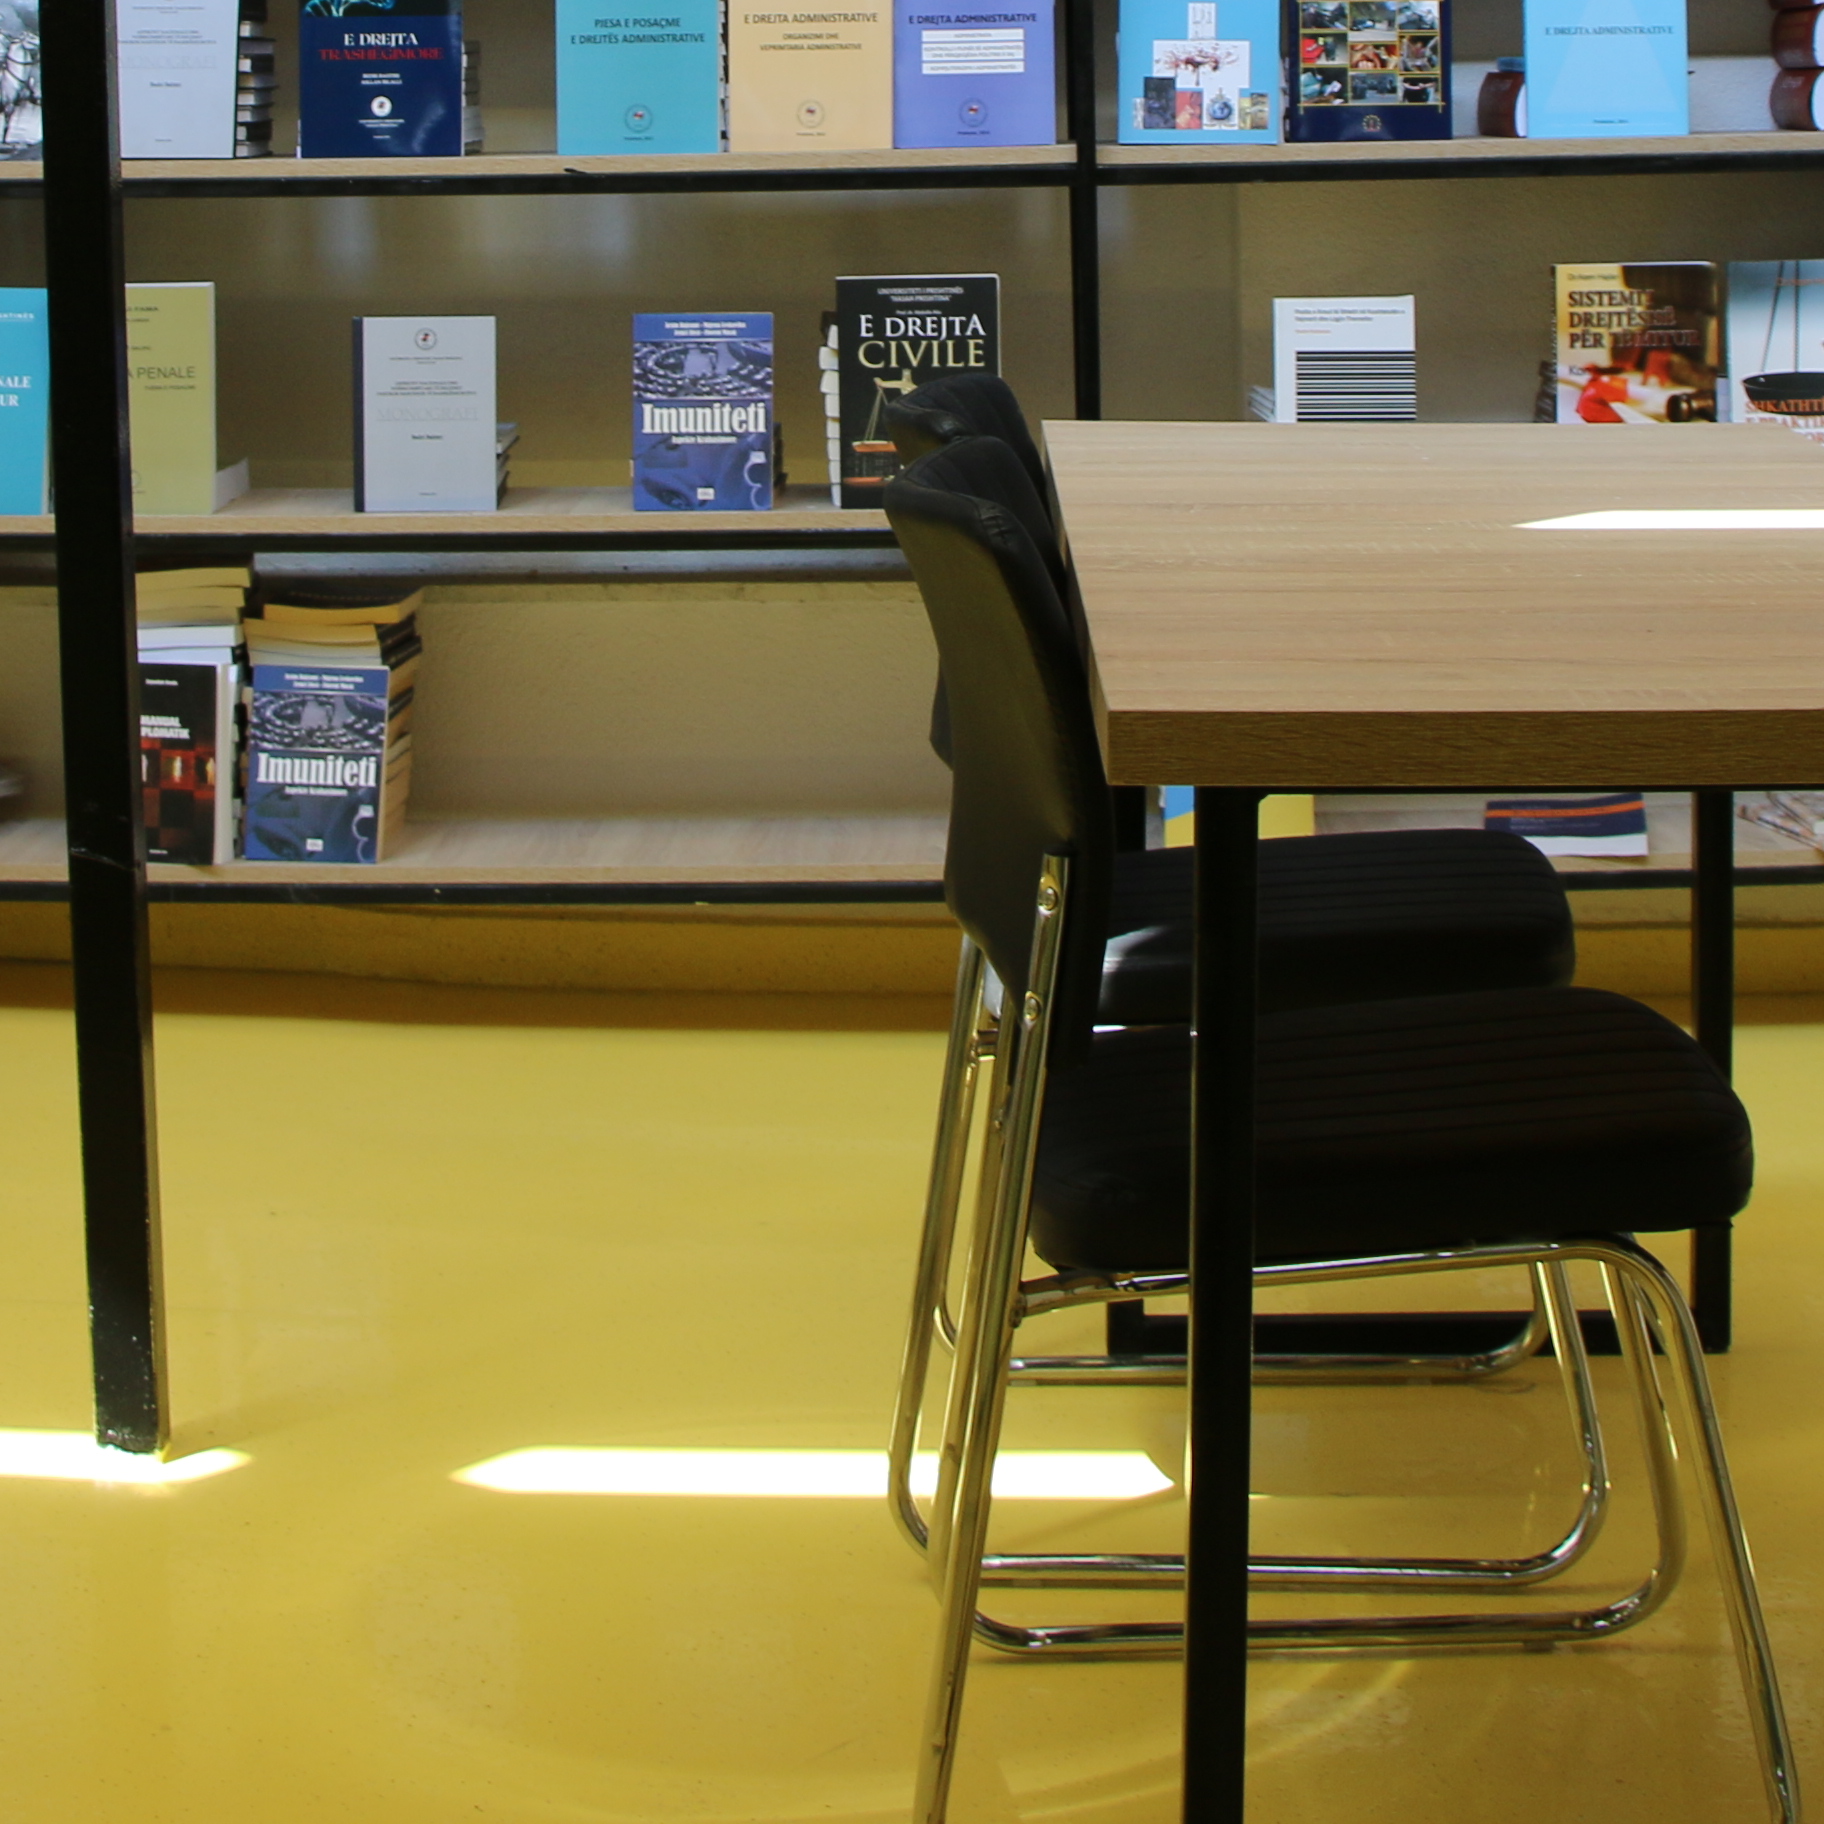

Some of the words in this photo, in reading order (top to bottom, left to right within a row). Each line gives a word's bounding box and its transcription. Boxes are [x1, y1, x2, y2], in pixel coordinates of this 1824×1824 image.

[595, 18, 621, 30] PJESA
[633, 18, 681, 30] POSAÇME
[753, 13, 790, 24] DREJTA
[792, 13, 878, 24] ADMINISTRATIVE
[917, 13, 952, 23] DREJTA
[955, 13, 1037, 23] ADMINISTRATIVE
[1591, 26, 1674, 35] ADMINISTRATIVE
[359, 33, 418, 45] DREJTA
[579, 32, 618, 43] DREJTËS
[622, 32, 705, 43] ADMINISTRATIVE
[320, 46, 443, 60] TRASHËGIMORE
[860, 317, 875, 337] E
[884, 315, 986, 345] DREJTA
[1568, 327, 1605, 348] PËR
[857, 339, 986, 368] CIVILE
[137, 366, 196, 378] PENALE
[642, 402, 767, 434] Imuniteti
[258, 753, 377, 787] Imuniteti
